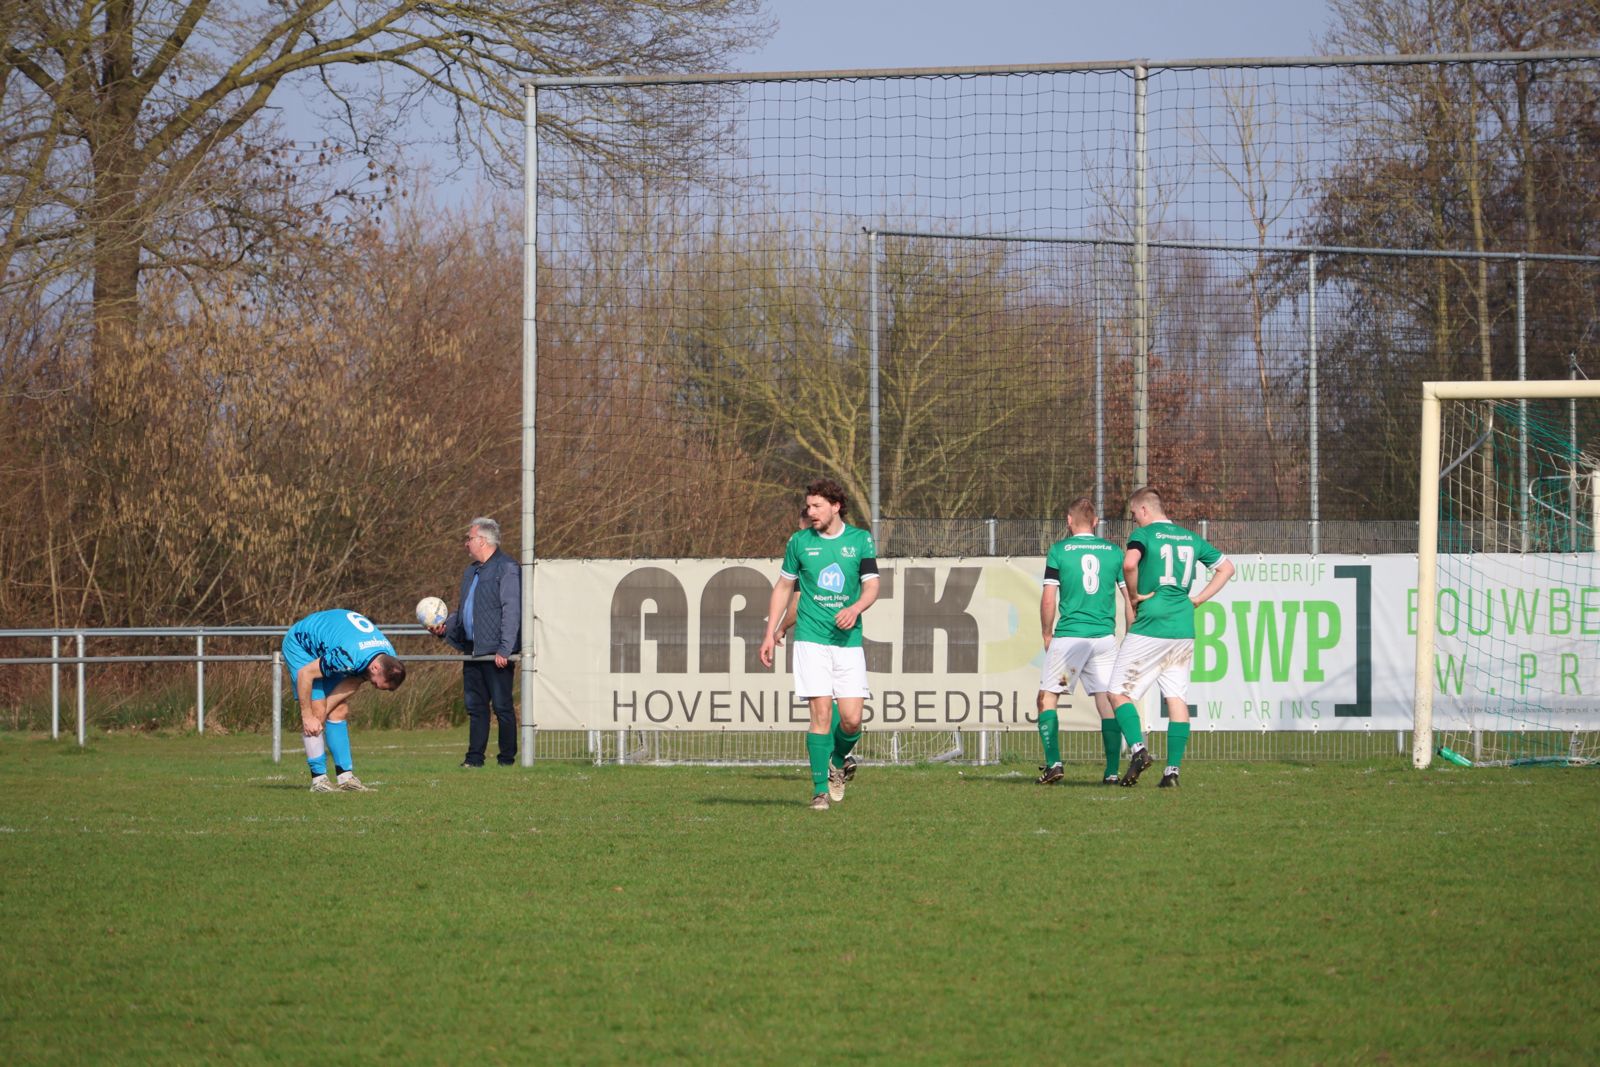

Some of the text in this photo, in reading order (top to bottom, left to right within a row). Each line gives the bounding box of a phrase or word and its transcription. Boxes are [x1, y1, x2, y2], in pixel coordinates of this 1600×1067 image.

[1081, 554, 1100, 594] 8
[1160, 544, 1194, 587] 17
[1205, 562, 1326, 586] BUWBEDRIJF
[1189, 600, 1342, 683] BWP
